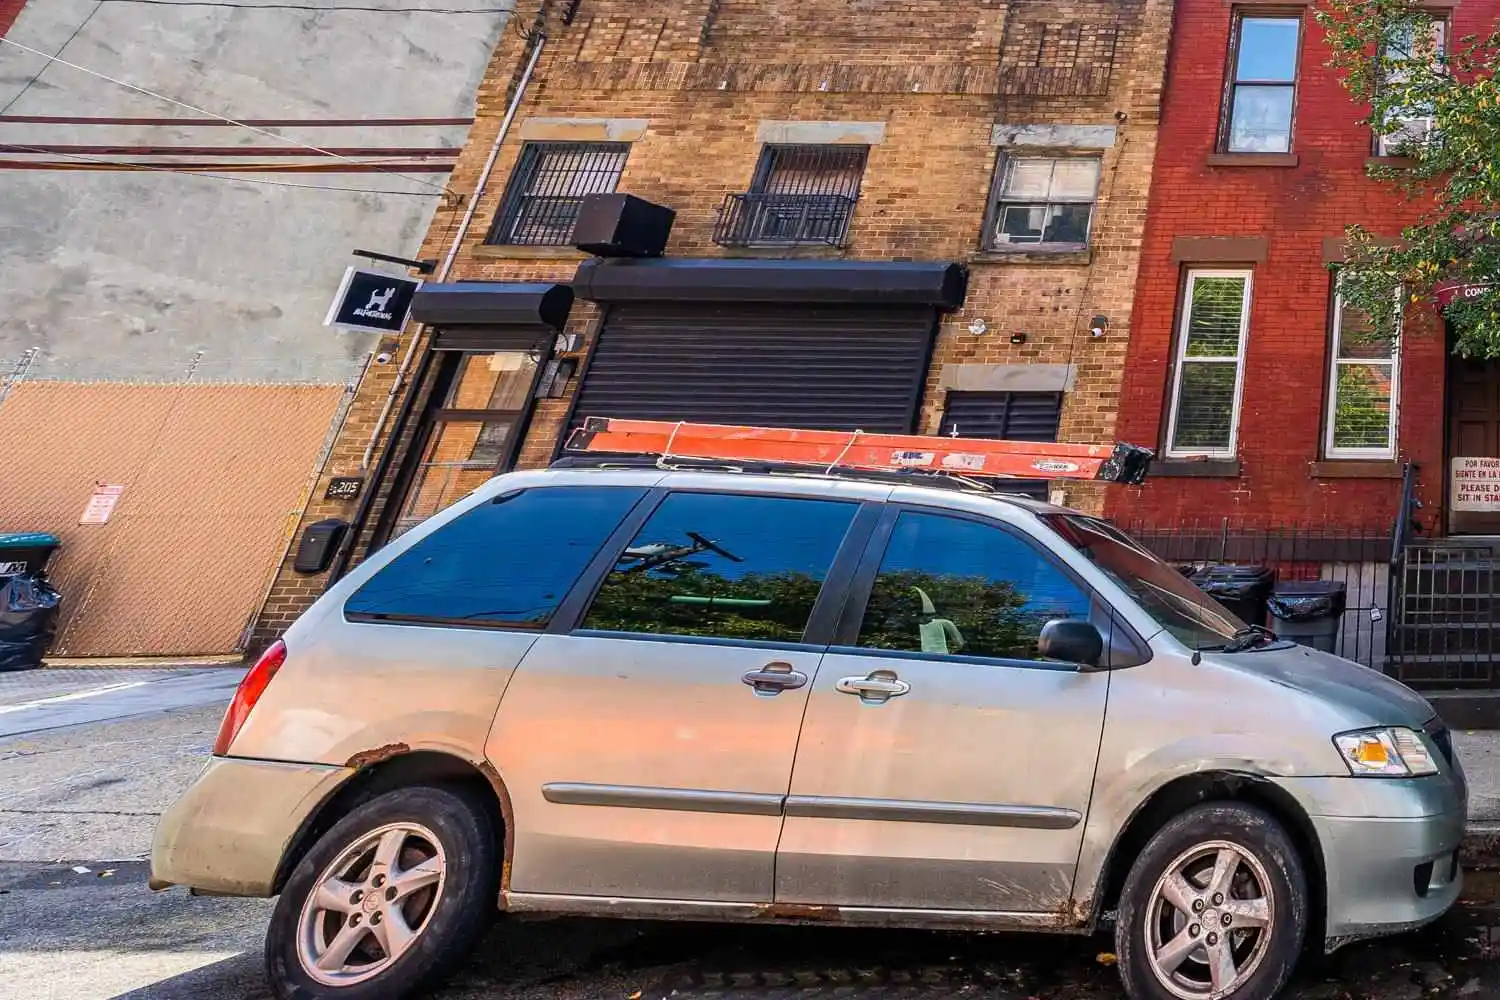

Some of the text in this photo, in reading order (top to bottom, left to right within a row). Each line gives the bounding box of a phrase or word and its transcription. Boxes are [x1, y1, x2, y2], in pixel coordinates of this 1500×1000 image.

[1465, 460, 1478, 468] POR
[1480, 460, 1500, 468] FAVOR
[1455, 469, 1476, 478] SIENTE
[1478, 470, 1486, 478] EN
[1488, 470, 1497, 479] LA
[337, 481, 360, 494] 205
[1461, 483, 1491, 492] PLEASE
[1457, 494, 1471, 502] SIT
[1473, 494, 1481, 502] IN
